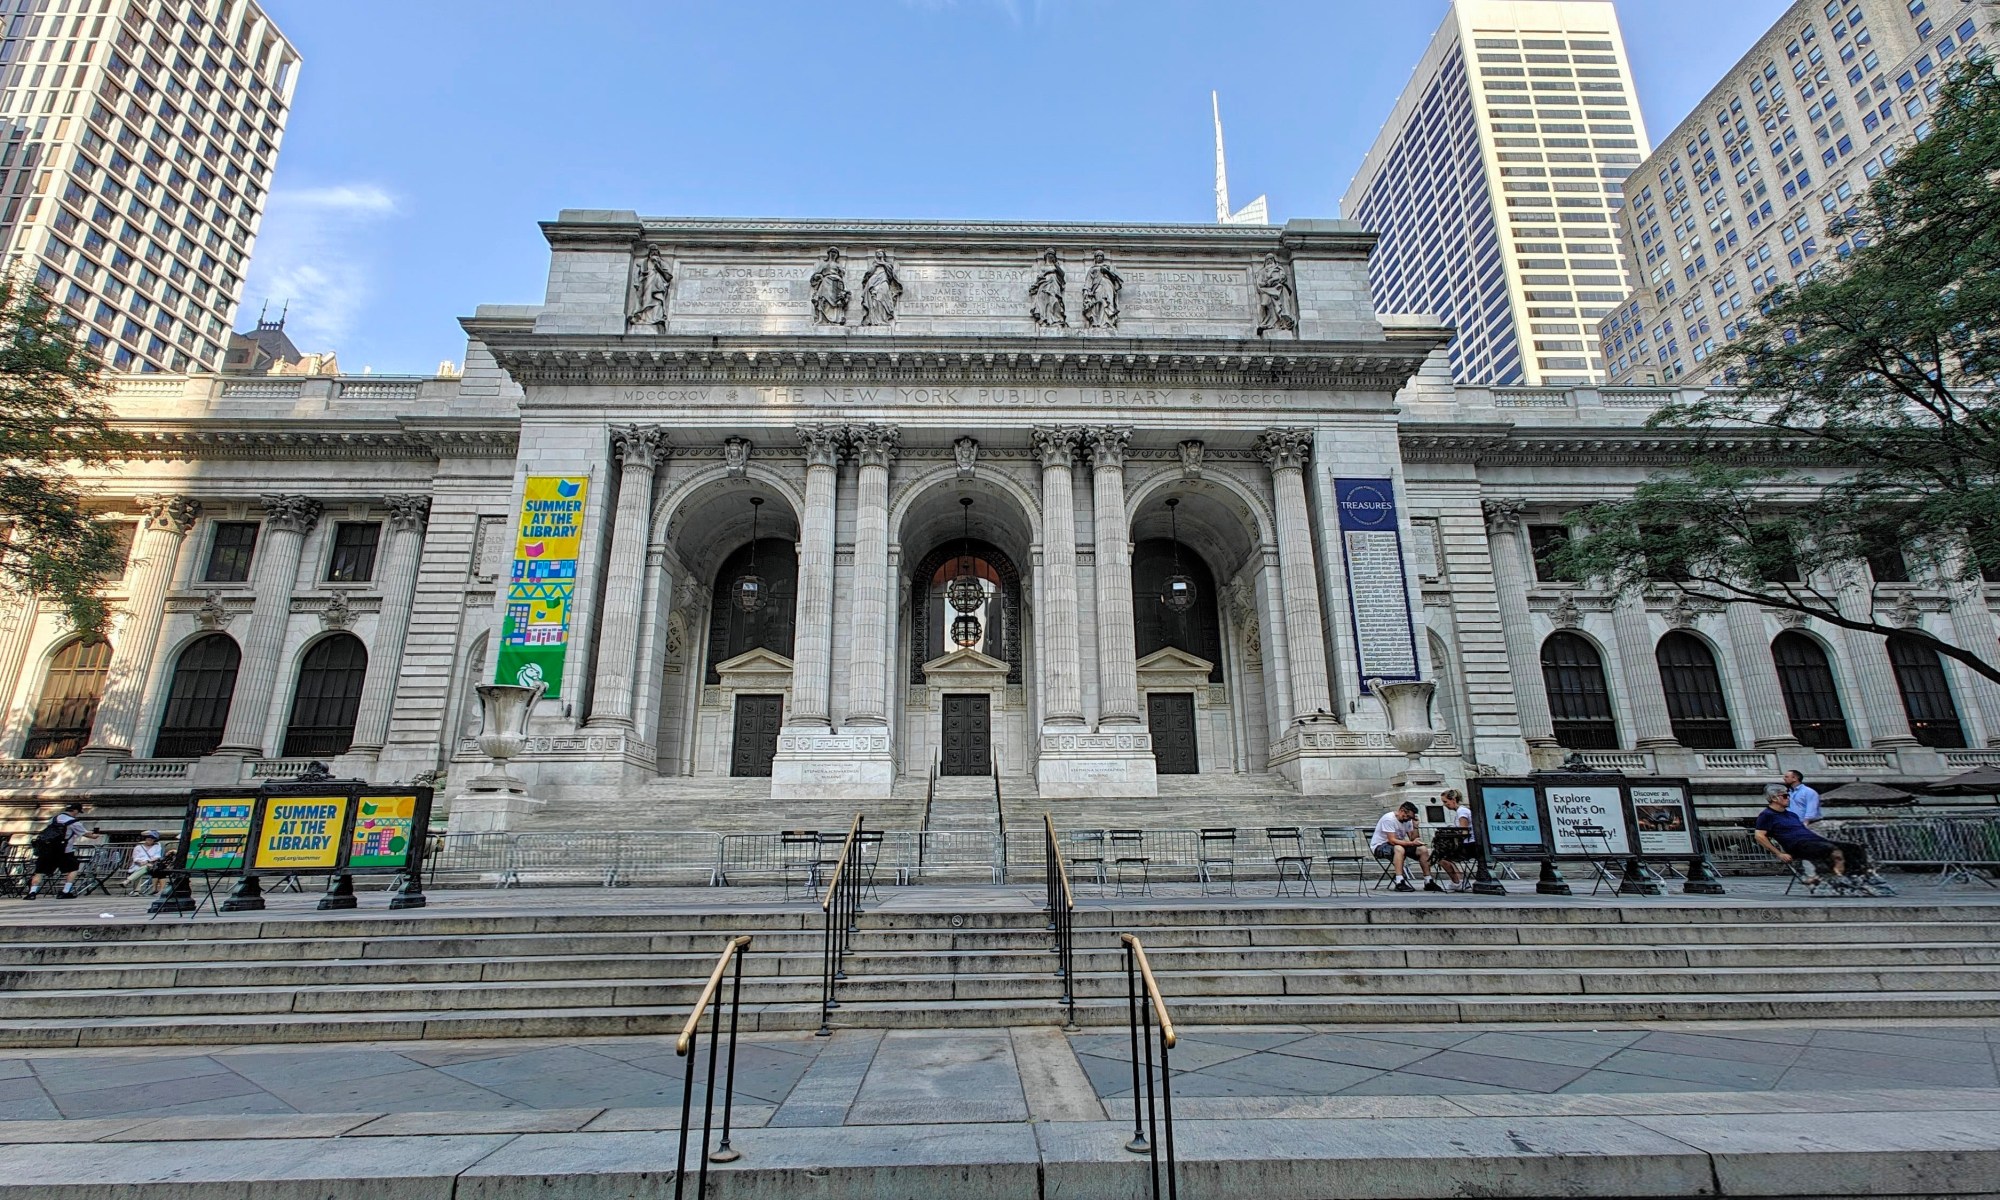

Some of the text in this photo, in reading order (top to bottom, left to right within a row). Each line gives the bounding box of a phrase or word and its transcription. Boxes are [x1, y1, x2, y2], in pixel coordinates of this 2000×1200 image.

[687, 268, 807, 278] THE ASTOR LIBRARY
[907, 269, 1027, 280] THE LENOX LIBRARY
[1123, 272, 1240, 283] THE TILDEN TRUST
[932, 288, 1000, 296] JAMES LENOX
[623, 391, 710, 401] MDCCCXCV
[757, 388, 805, 402] THE
[823, 389, 879, 402] NEW
[901, 389, 960, 403] YORK
[978, 389, 1058, 404] PUBLIC
[1079, 390, 1172, 405] LIBRARY
[525, 500, 582, 512] SUMMER
[1340, 501, 1392, 510] TREASURES
[531, 513, 573, 525] AT THE
[522, 525, 578, 538] LIBRARY
[1553, 793, 1591, 805] Explore
[273, 805, 338, 819] SUMMER
[1554, 805, 1606, 814] What's On
[1556, 817, 1593, 826] Now at
[278, 820, 327, 835] AT THE
[1558, 828, 1575, 837] the
[268, 835, 332, 850] LIBRARY
